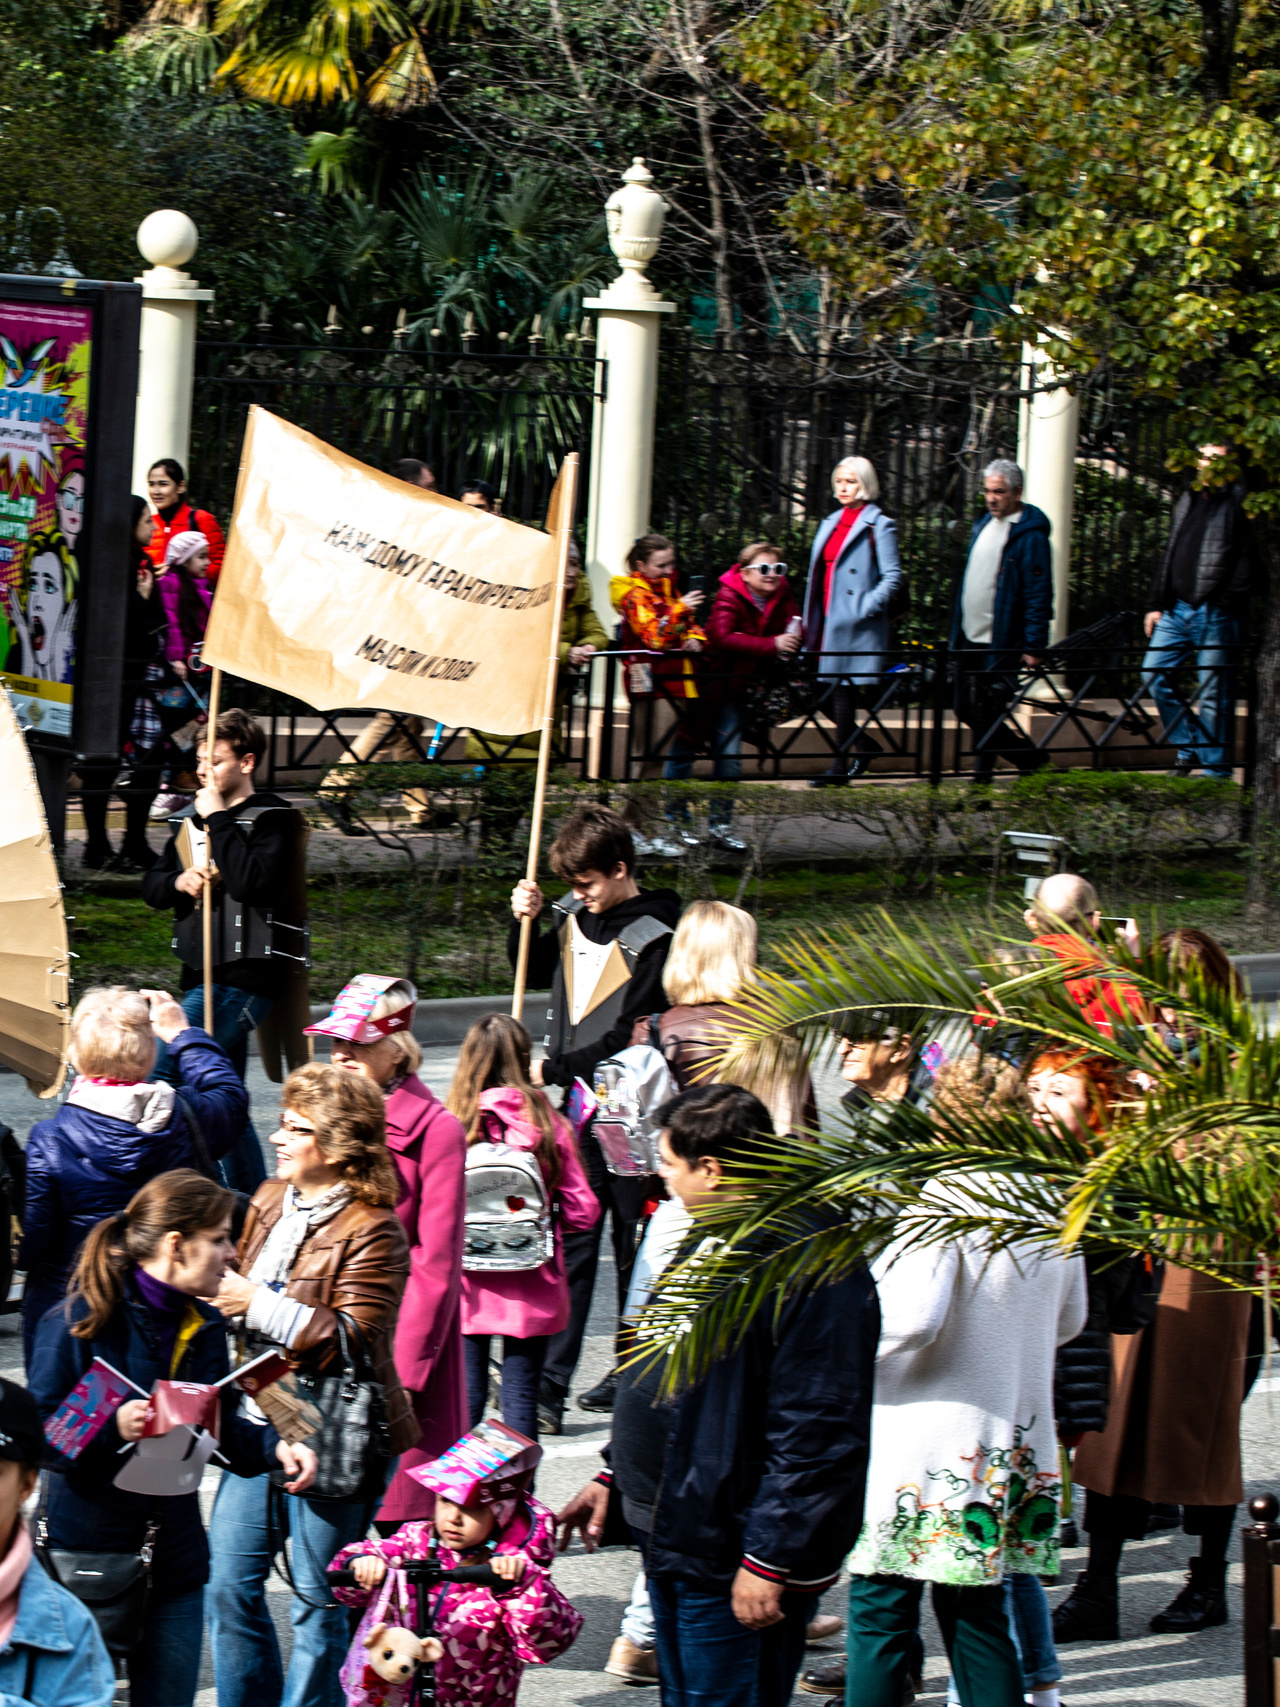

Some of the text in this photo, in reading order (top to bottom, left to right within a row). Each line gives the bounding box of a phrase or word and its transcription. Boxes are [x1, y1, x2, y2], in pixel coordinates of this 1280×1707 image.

[323, 519, 428, 578] КАЖДОМУ
[354, 634, 429, 675] МЫСЛИ
[413, 655, 441, 677] И
